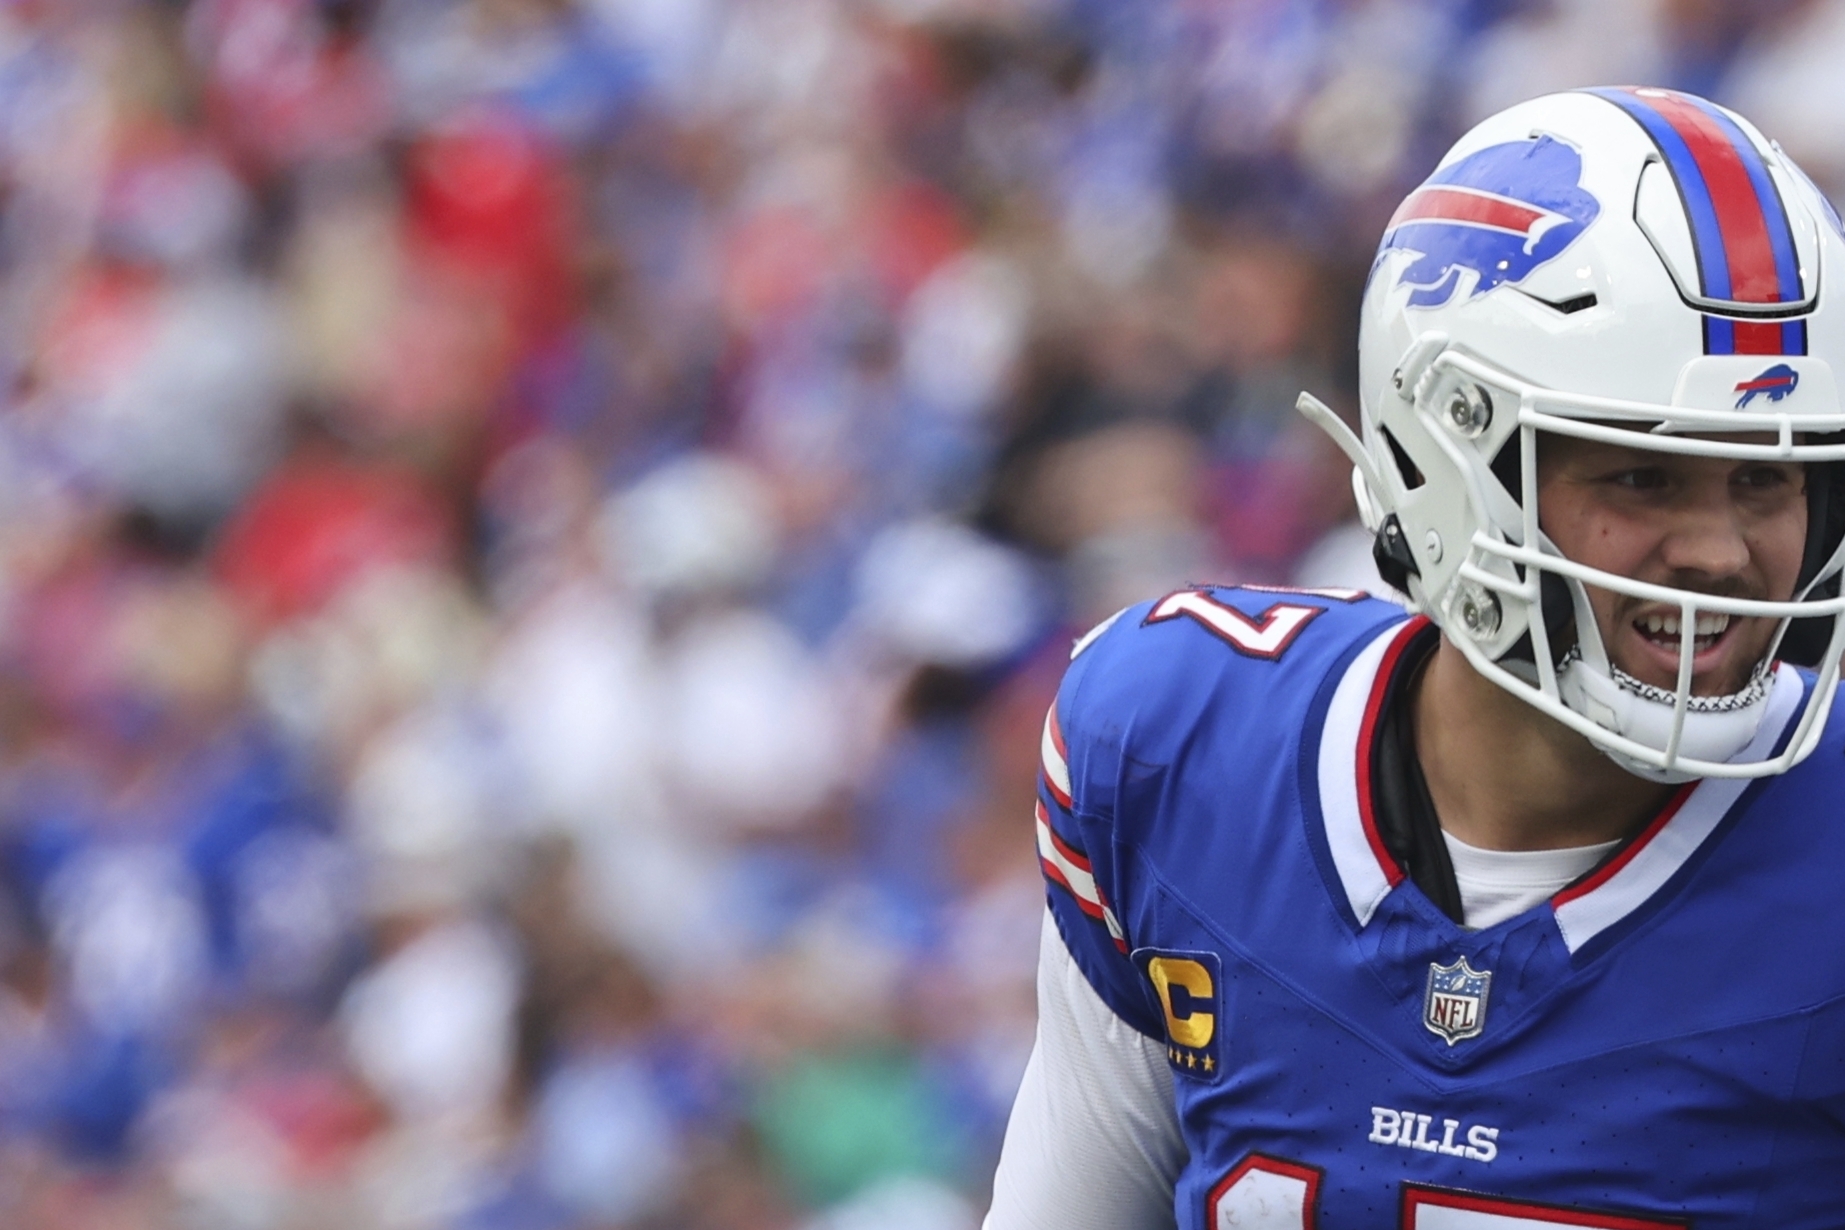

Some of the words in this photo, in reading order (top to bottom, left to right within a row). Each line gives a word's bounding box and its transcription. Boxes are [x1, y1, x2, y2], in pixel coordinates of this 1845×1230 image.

[1148, 956, 1214, 1048] C
[1432, 996, 1474, 1030] NFL
[1369, 1106, 1500, 1162] BILLS
